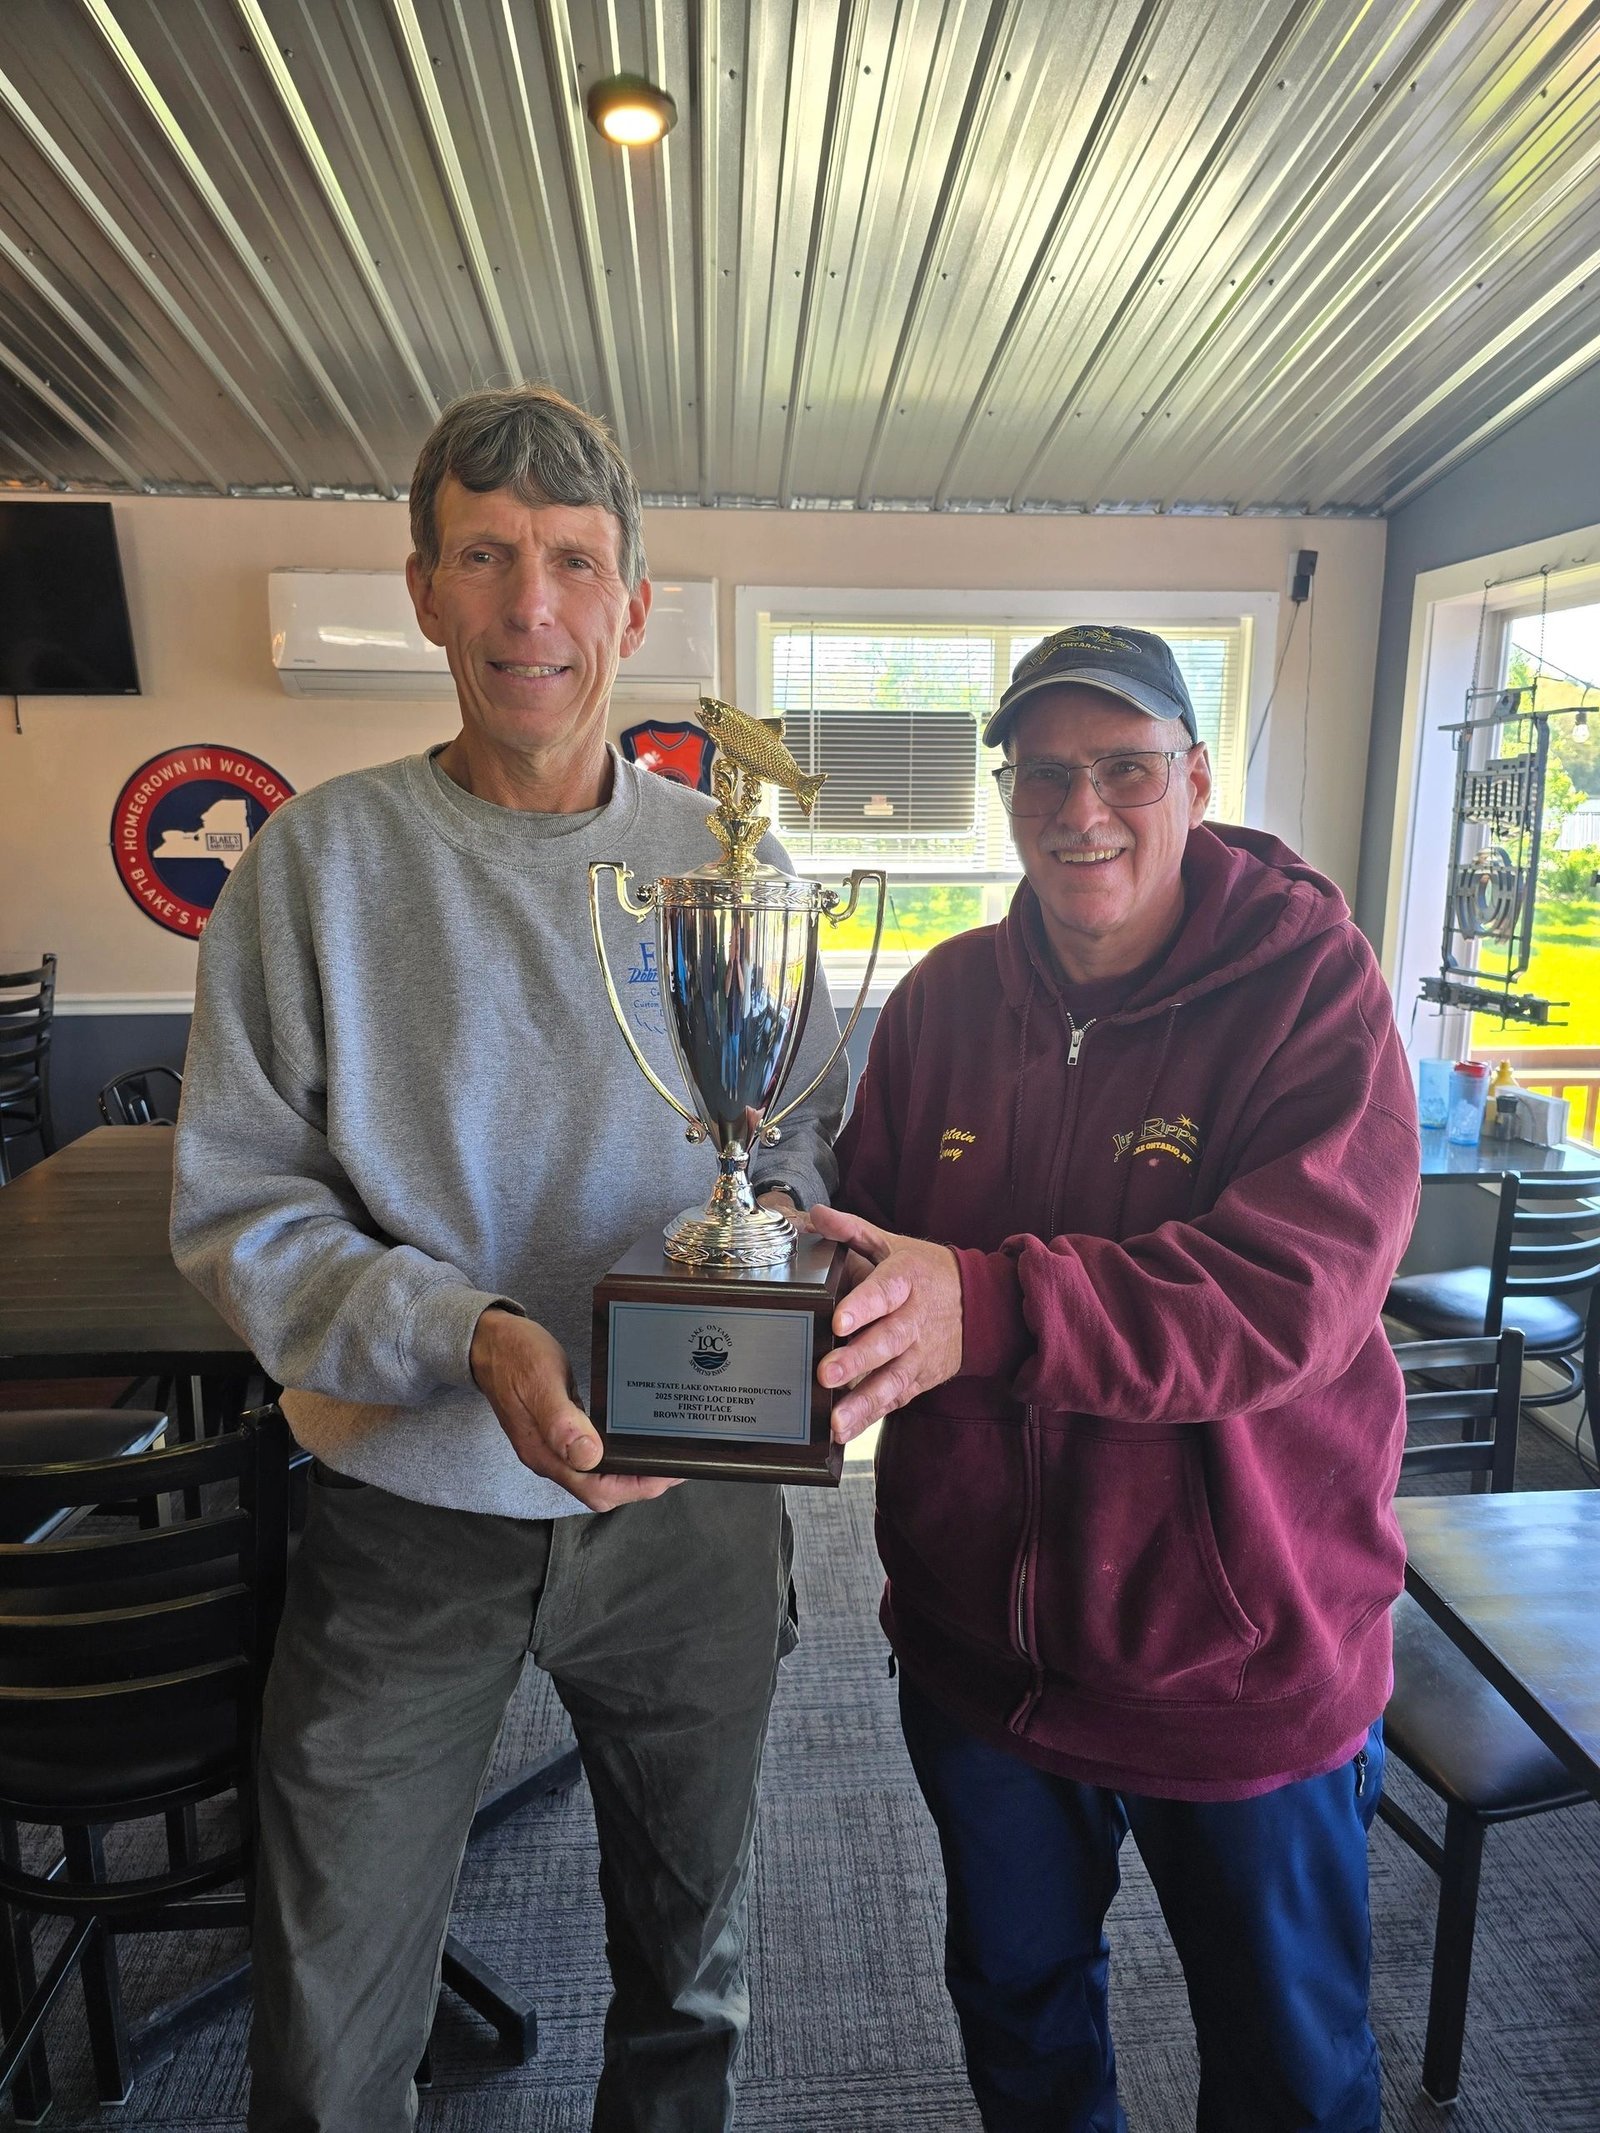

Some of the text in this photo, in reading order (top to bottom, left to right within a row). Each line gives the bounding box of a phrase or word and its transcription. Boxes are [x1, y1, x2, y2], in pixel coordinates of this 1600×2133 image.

[124, 756, 286, 851] HOMEGROWN IN WOLCOT
[131, 868, 190, 925] BLAKE'S
[1140, 1117, 1198, 1147] Rippe
[688, 1324, 733, 1347] LAKE ONTARIO
[697, 1335, 724, 1352] LOC
[627, 1380, 792, 1396] EMPIRE STATE LAKE ONTARIO PRODUCTIONS
[655, 1392, 756, 1405] 2025 SPRING LOC DERBY
[678, 1403, 733, 1413] FIRST PLACE
[653, 1410, 757, 1424] BROWN TROUT DIVISION
